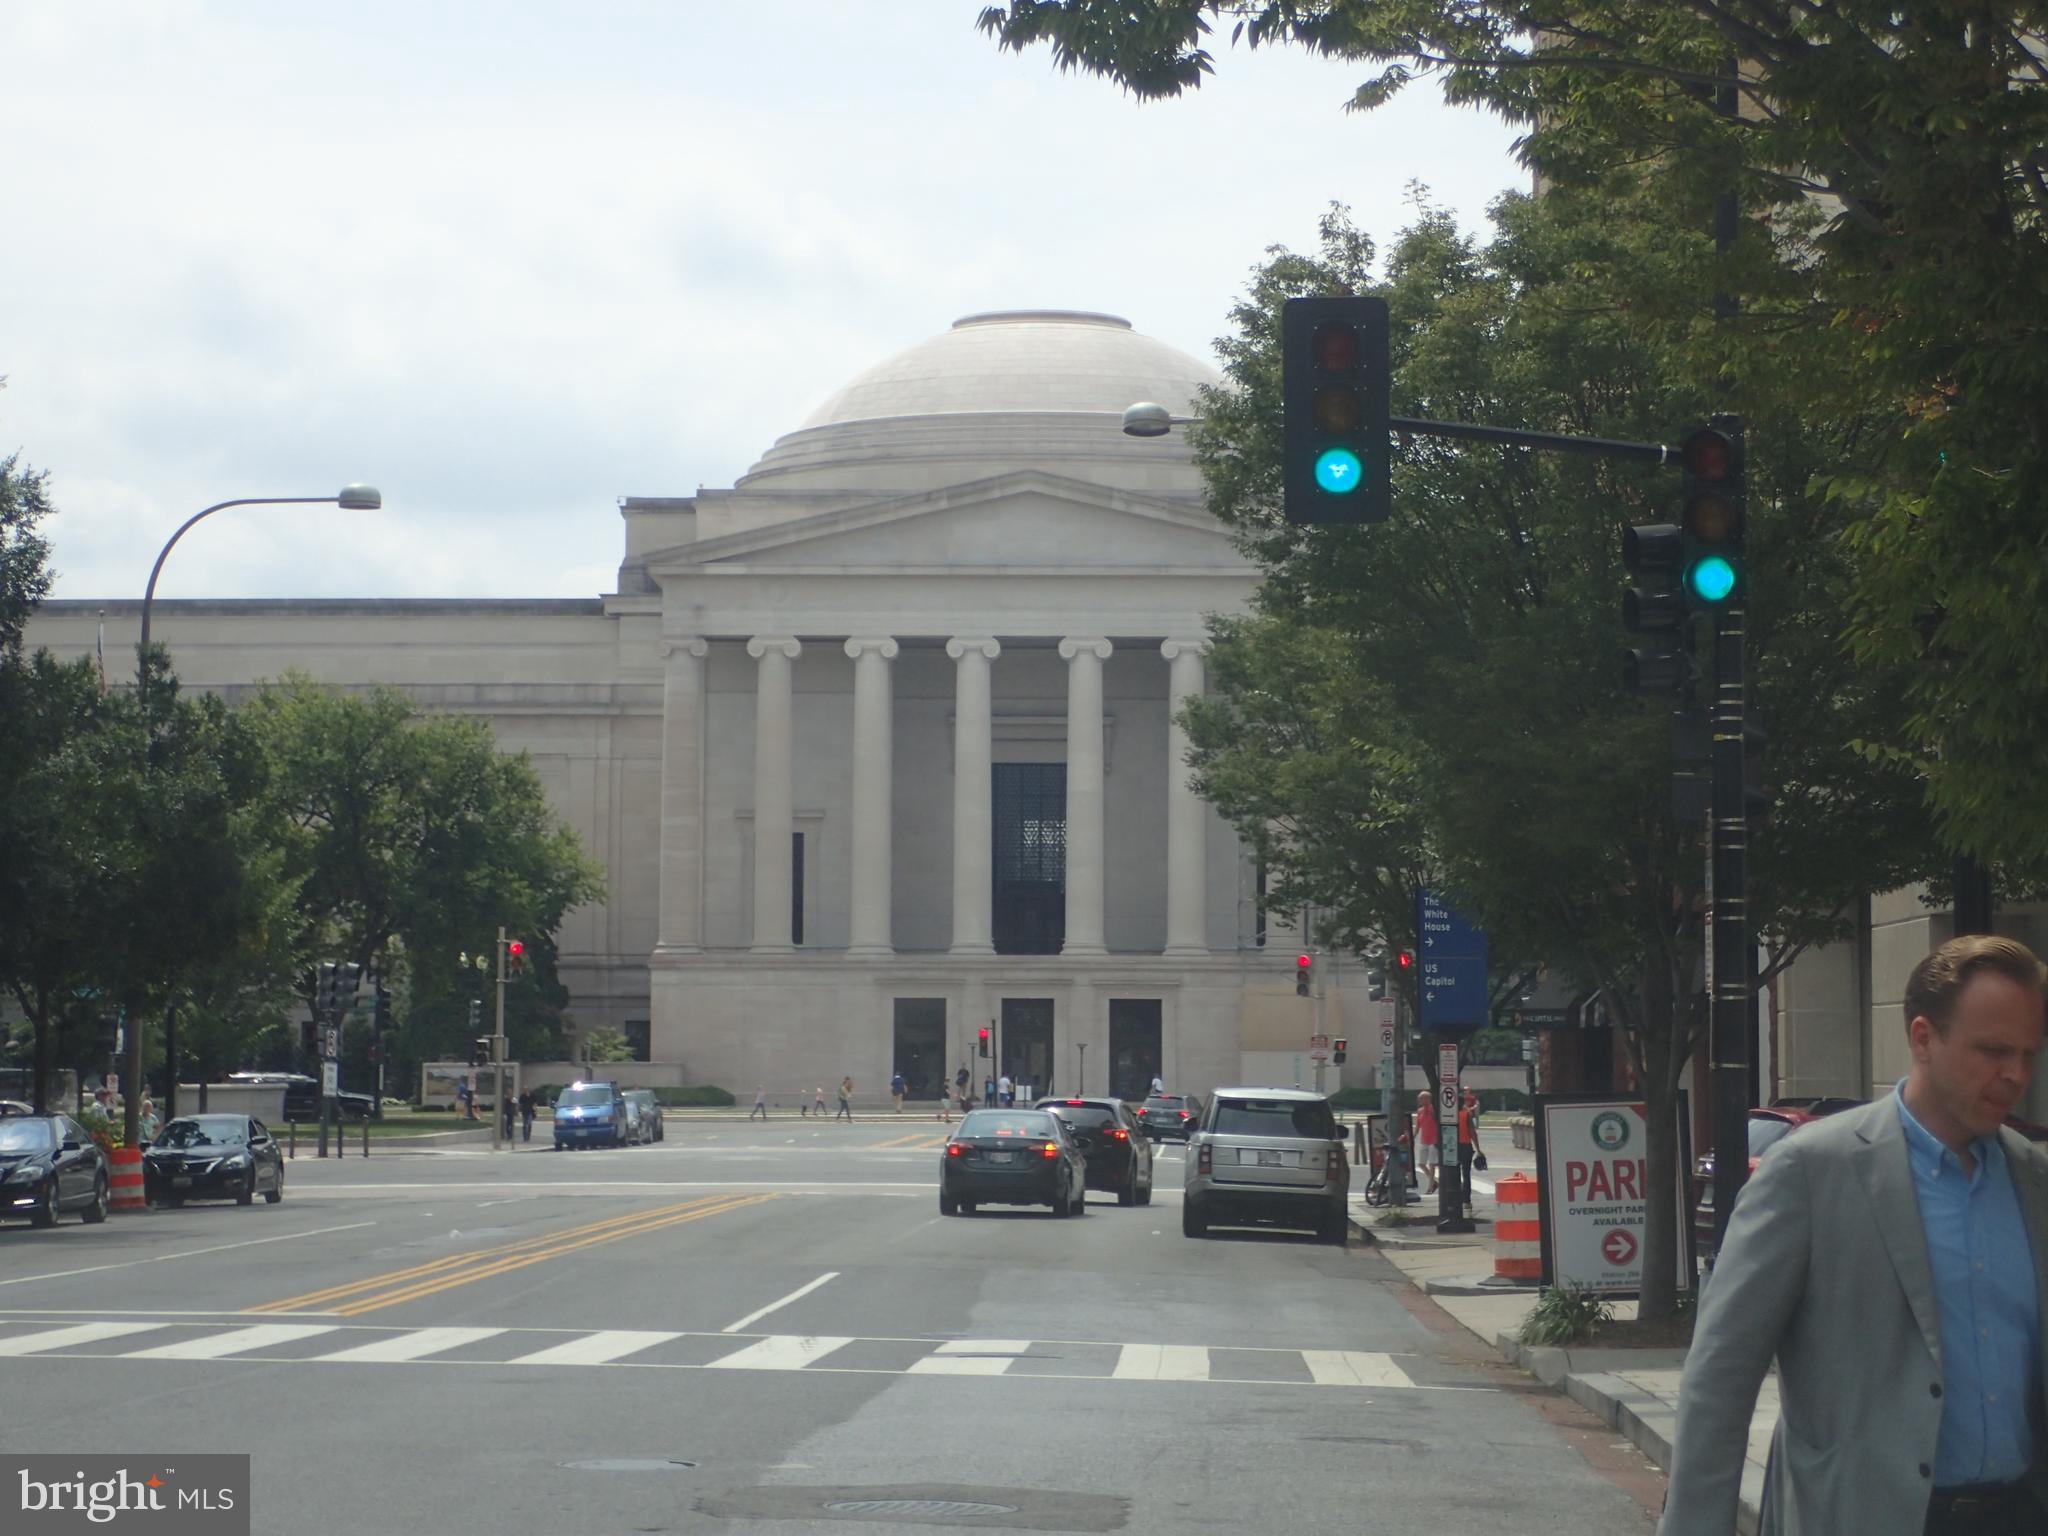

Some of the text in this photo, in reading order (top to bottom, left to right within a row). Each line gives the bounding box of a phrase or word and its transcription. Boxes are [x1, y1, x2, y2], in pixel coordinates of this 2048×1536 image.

[1424, 897, 1439, 906] The
[1424, 910, 1448, 919] White
[1424, 922, 1451, 931] House
[1425, 964, 1438, 973] US
[1425, 976, 1455, 987] Capitol
[1568, 1206, 1623, 1215] OVERNIGHT
[1593, 1217, 1644, 1226] AVAILABLE
